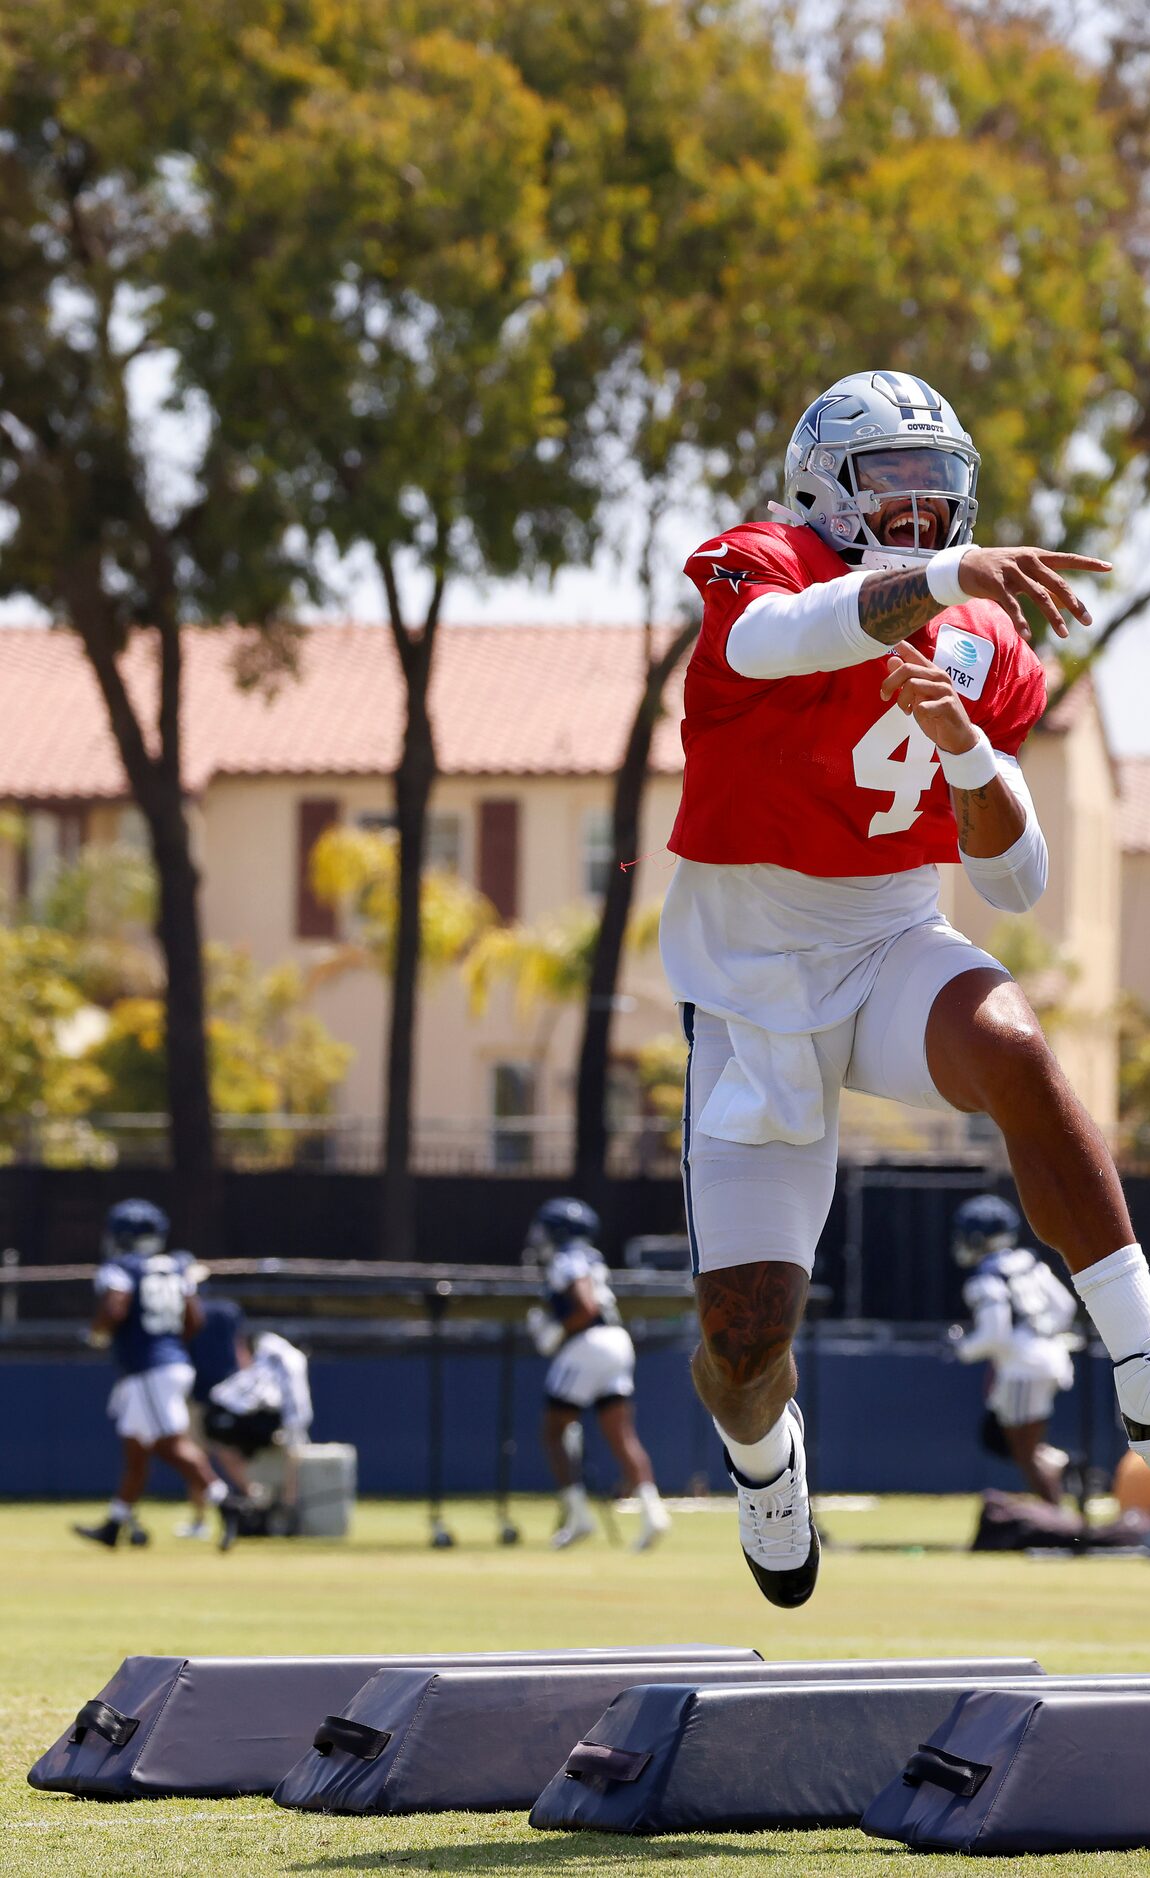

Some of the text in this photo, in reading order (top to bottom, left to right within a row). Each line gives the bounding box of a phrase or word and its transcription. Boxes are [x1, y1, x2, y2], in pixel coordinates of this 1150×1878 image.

[907, 423, 944, 433] COWBOYS
[945, 666, 975, 688] AT&T
[852, 702, 941, 839] 4
